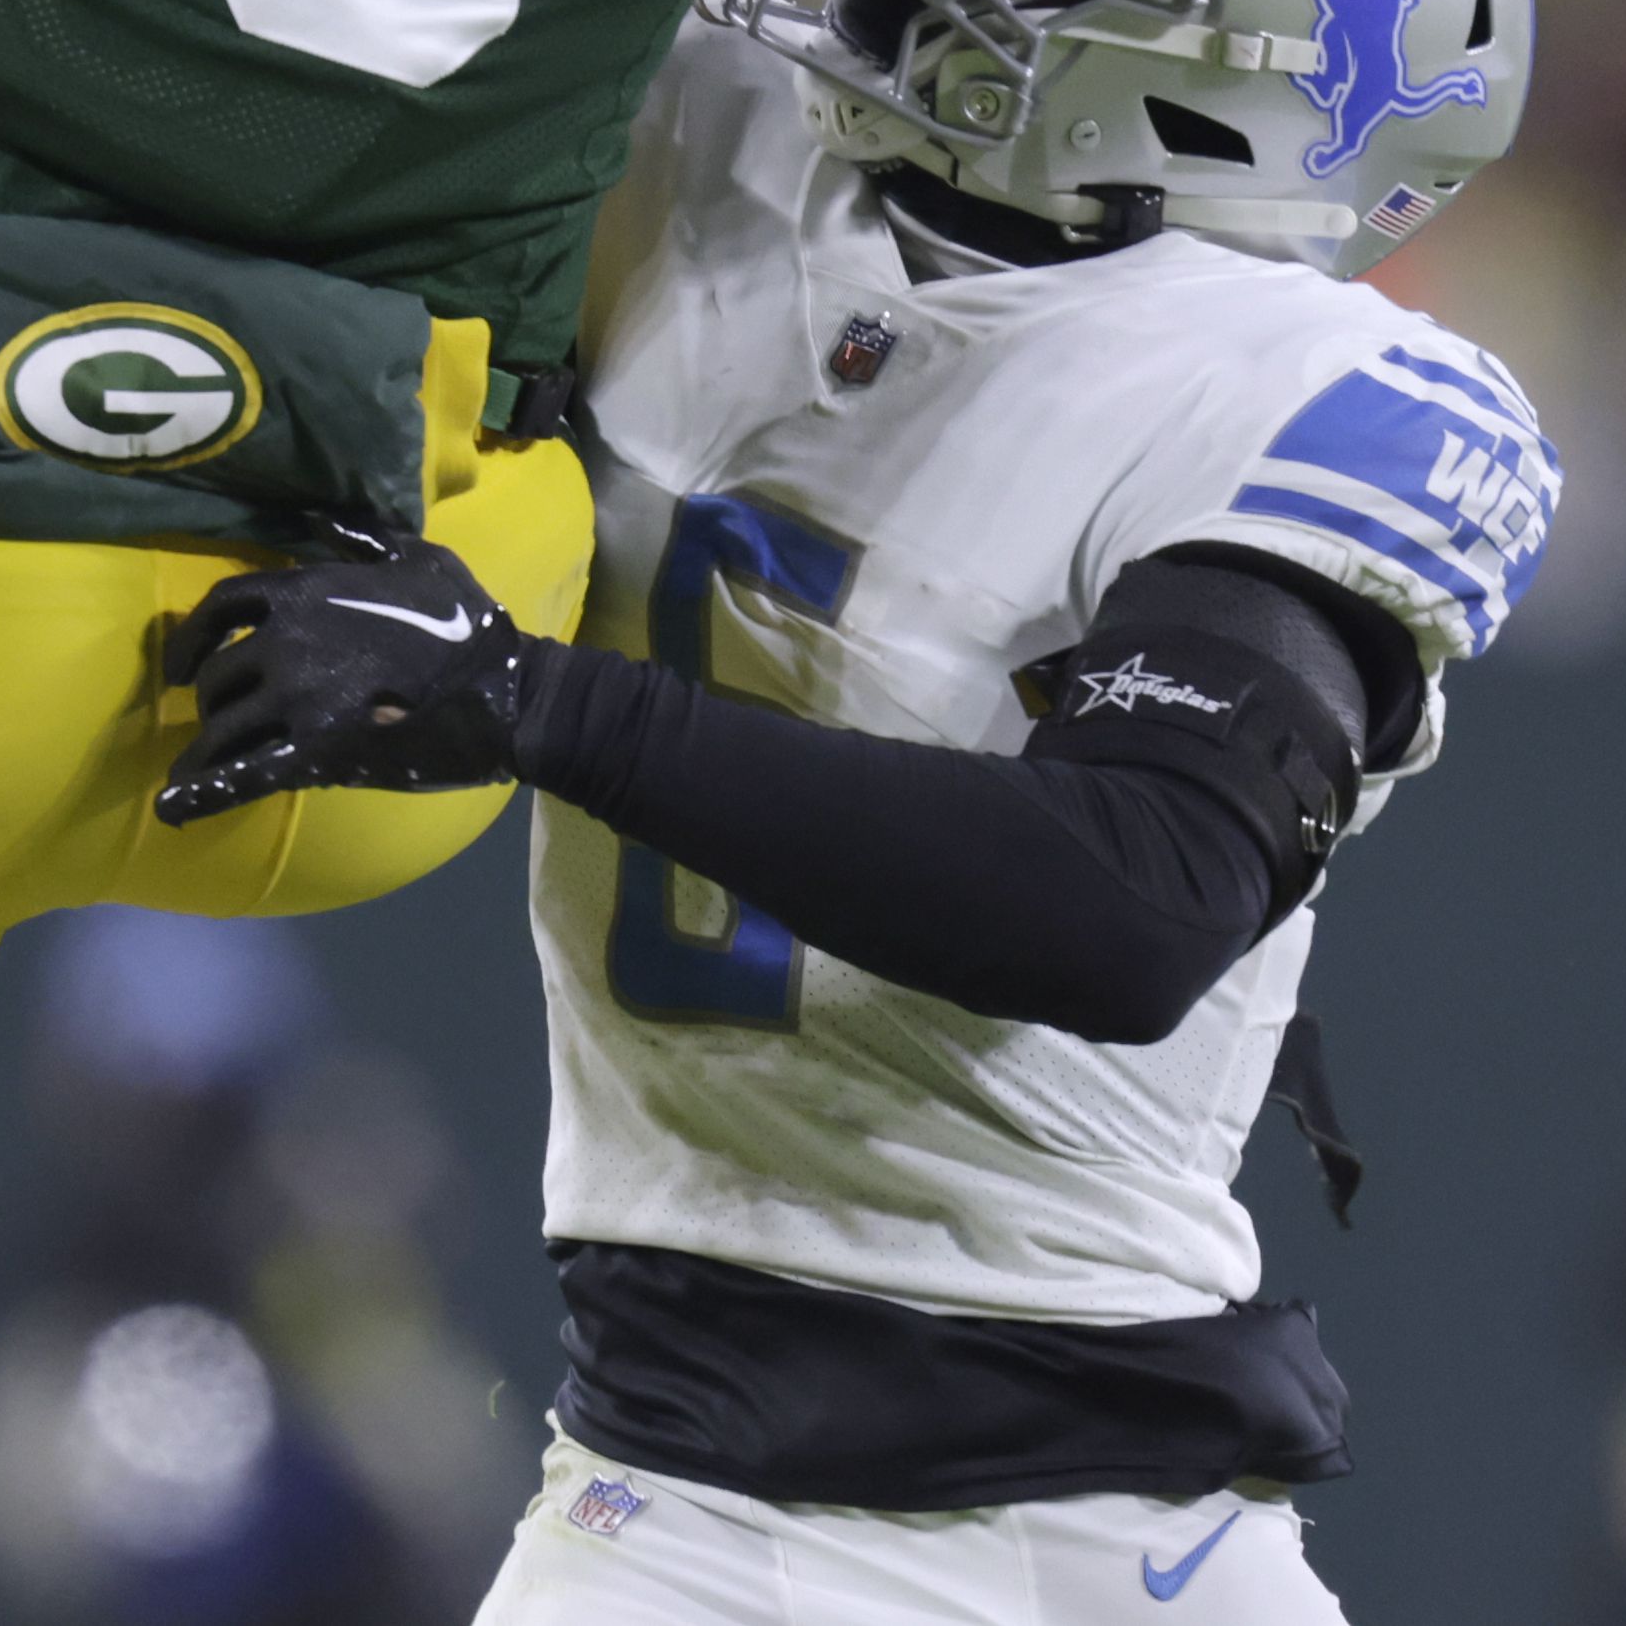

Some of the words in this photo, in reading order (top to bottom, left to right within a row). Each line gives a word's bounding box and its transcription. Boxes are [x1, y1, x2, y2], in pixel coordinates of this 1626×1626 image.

[13, 326, 234, 459] G
[1105, 673, 1221, 715] Douglas
[573, 1494, 626, 1532] NFL
